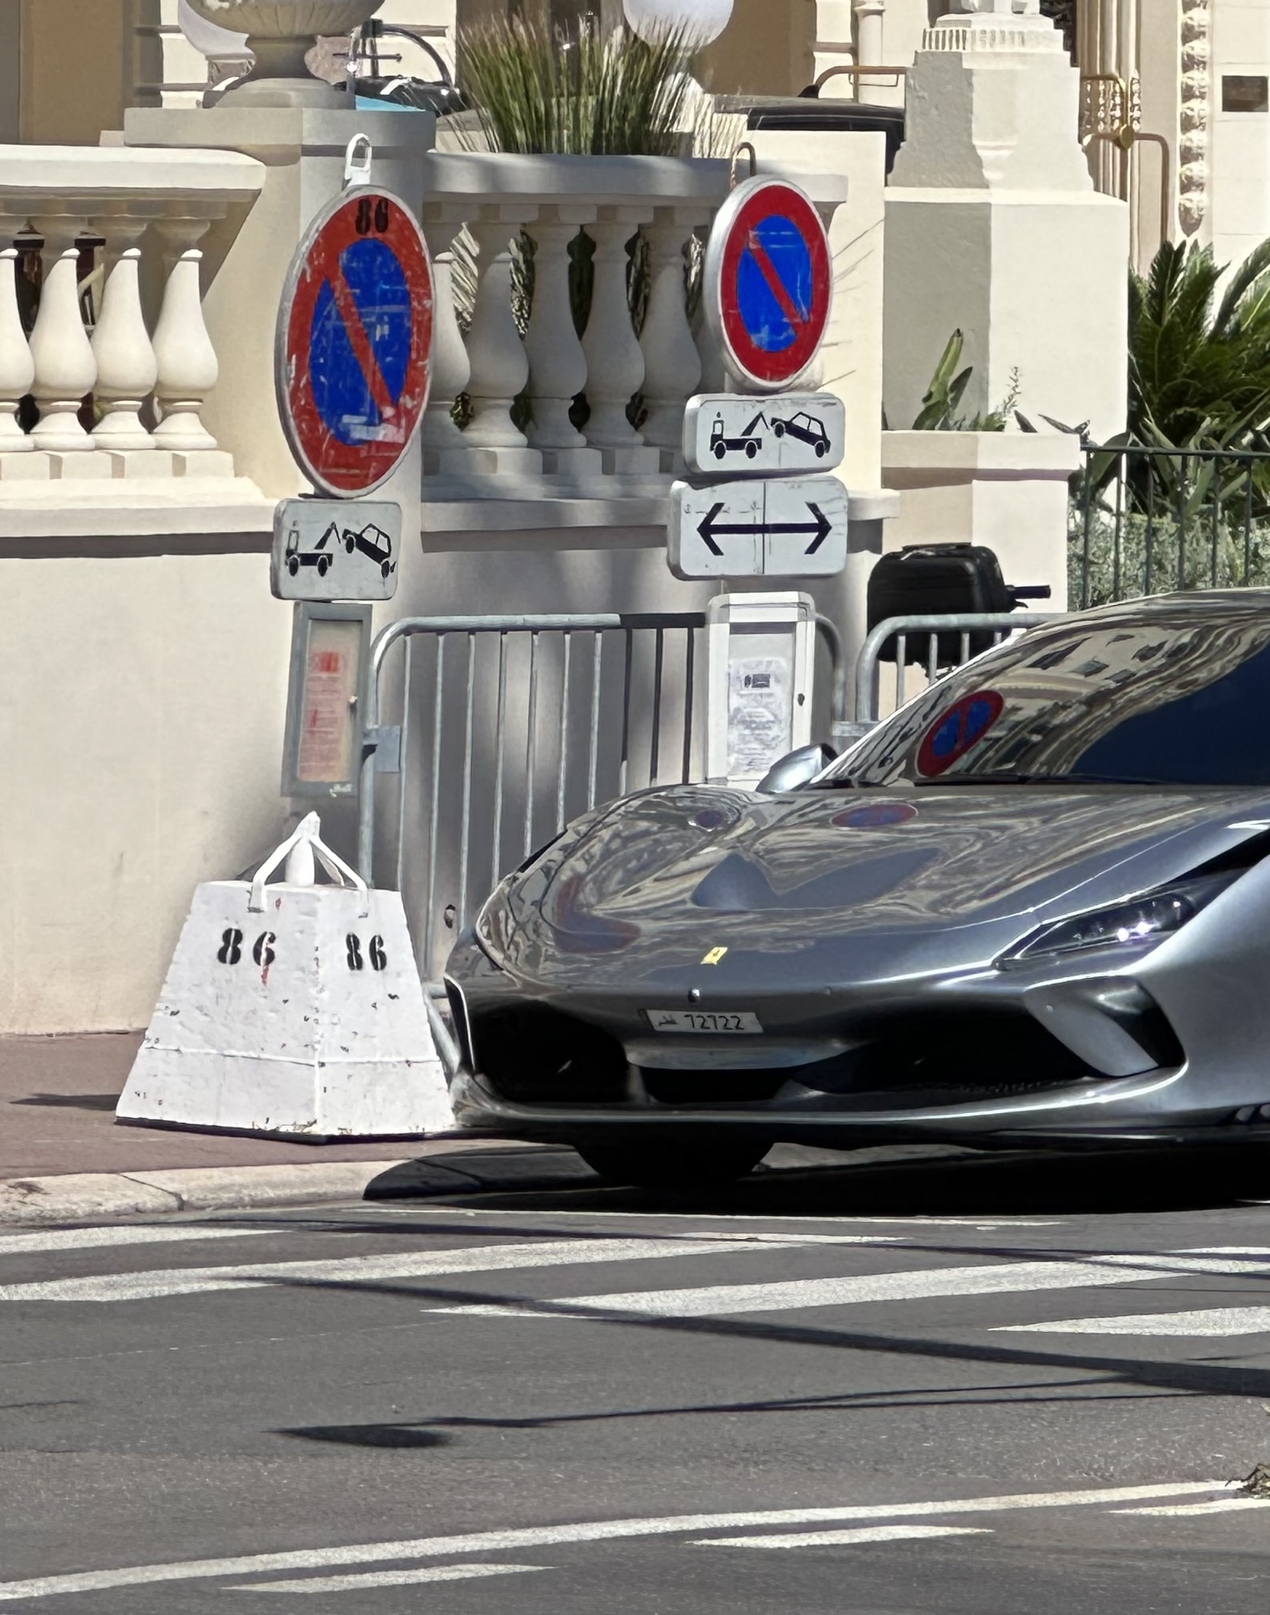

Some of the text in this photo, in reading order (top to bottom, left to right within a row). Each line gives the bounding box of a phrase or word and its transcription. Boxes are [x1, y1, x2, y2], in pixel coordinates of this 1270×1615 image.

[355, 198, 389, 235] 86
[217, 927, 277, 967] 86
[345, 932, 388, 972] 86
[683, 1013, 745, 1031] 72722
